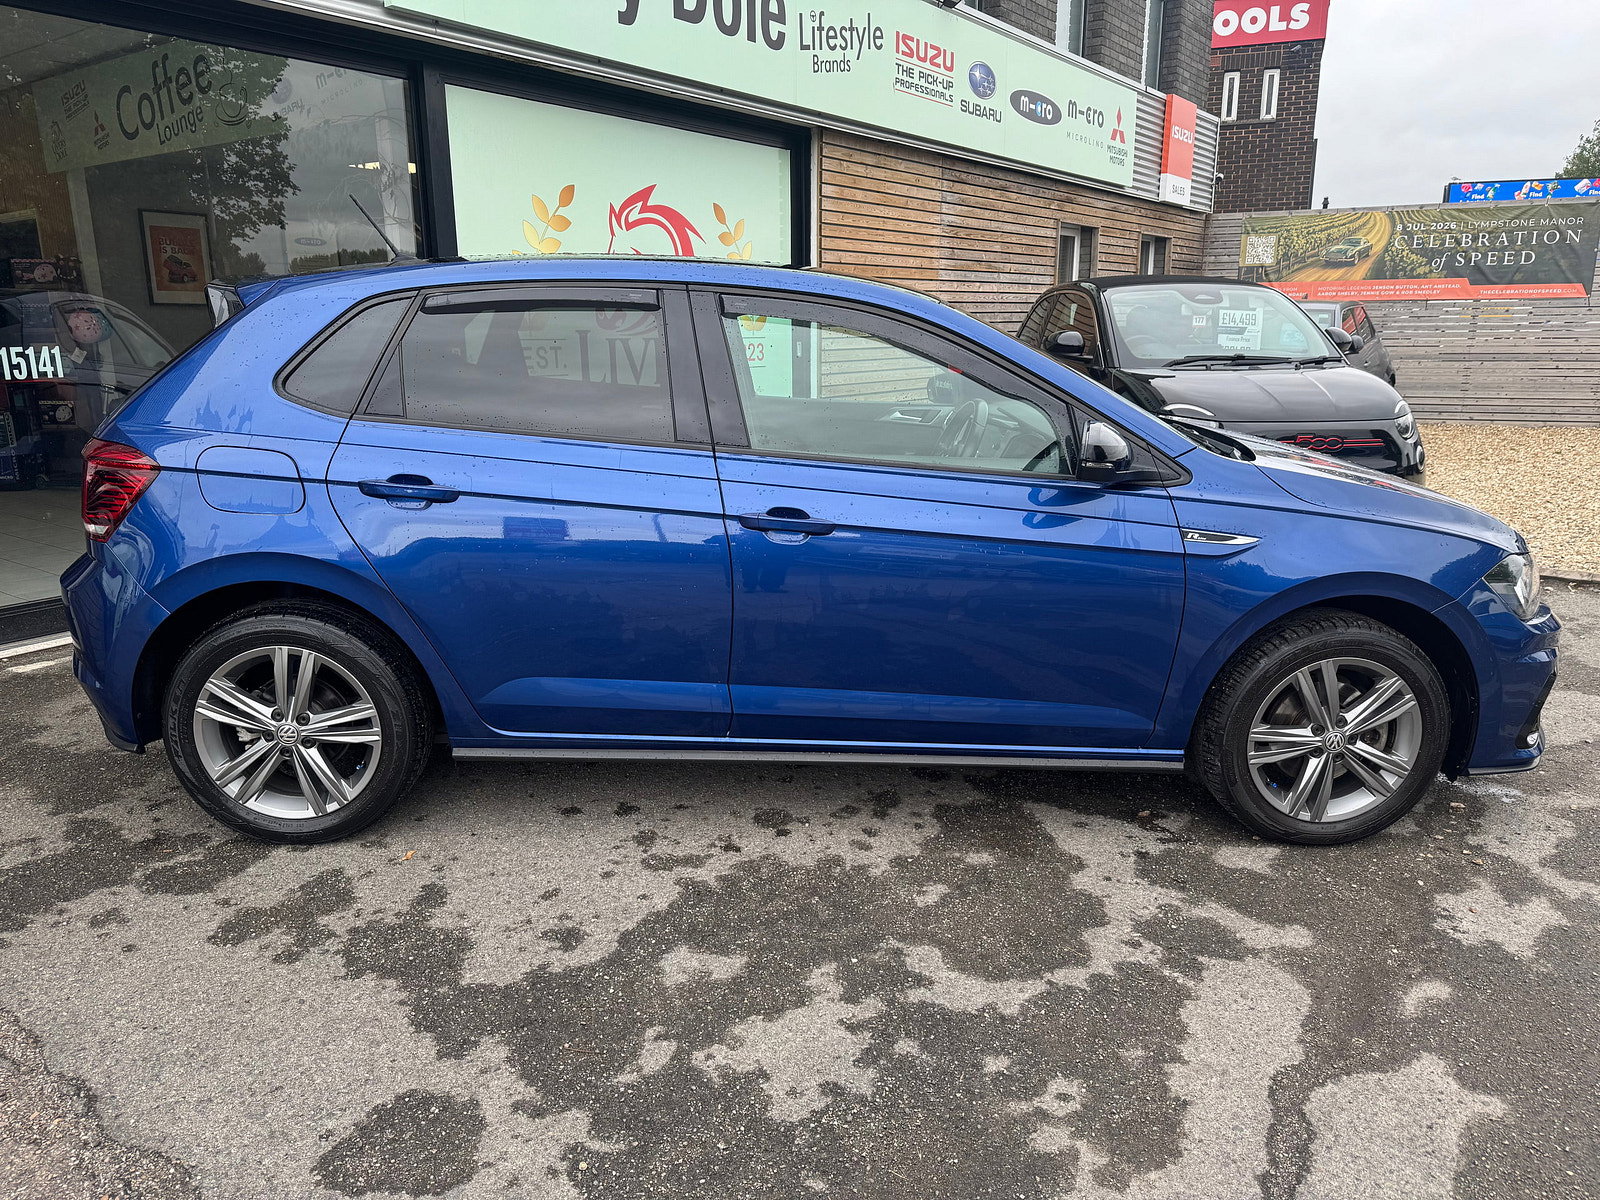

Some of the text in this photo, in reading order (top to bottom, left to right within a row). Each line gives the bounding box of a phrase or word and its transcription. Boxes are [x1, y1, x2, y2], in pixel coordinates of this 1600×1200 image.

[799, 10, 884, 60] Lifestyle
[895, 31, 955, 72] ISUZU
[812, 53, 851, 73] Brands
[895, 63, 954, 91] THE PICK-UP
[116, 53, 212, 140] Coffee
[895, 77, 954, 103] PROFESSIONALS
[960, 99, 1002, 123] SUBARU
[156, 105, 204, 145] Lounge
[1172, 125, 1194, 144] ISUZU
[1066, 131, 1104, 149] MICROLINO
[1106, 144, 1128, 158] MITSUBISHI
[1109, 155, 1125, 167] MOTORS
[1172, 184, 1186, 197] SALES
[1396, 217, 1584, 231] 8 JUL 2026 LYMPSTONE MANOR
[1394, 229, 1582, 249] CELEBRATION
[1431, 250, 1536, 272] of SPEED
[1221, 312, 1257, 326] £14,499
[0, 346, 64, 380] 15141
